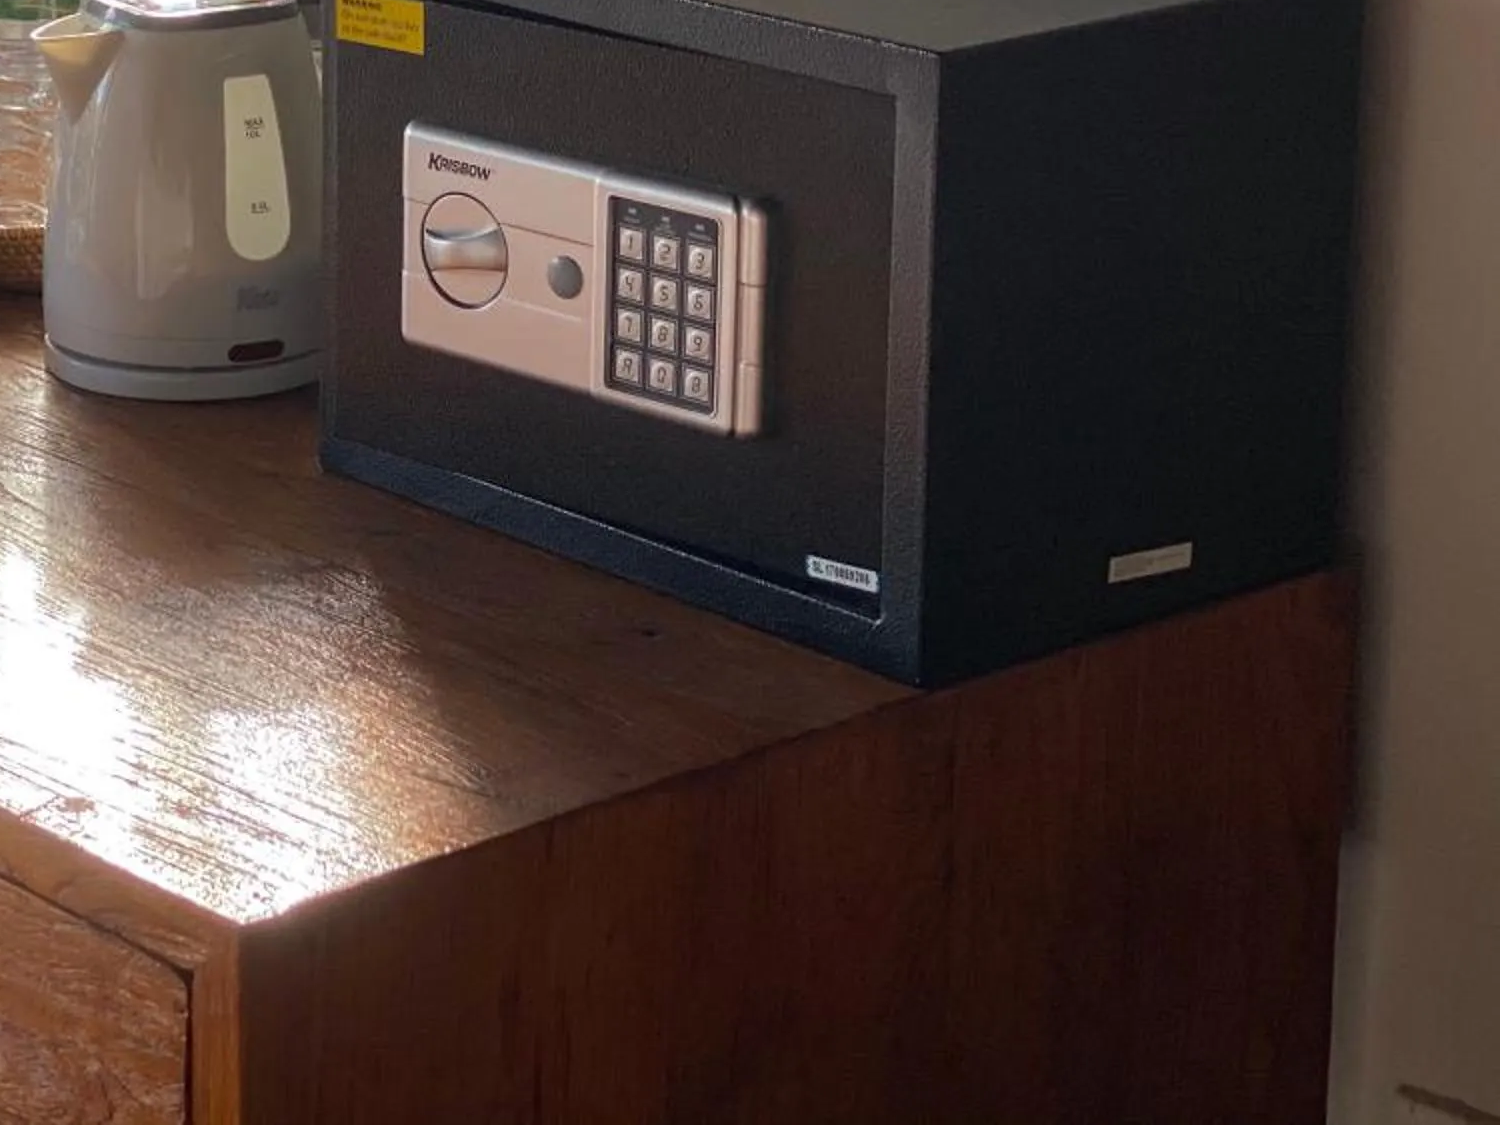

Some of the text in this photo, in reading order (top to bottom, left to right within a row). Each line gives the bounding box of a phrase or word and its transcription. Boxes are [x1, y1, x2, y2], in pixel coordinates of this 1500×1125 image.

[658, 243, 671, 262] 2
[695, 252, 705, 270] 3
[624, 274, 704, 311] 4 5 6
[624, 315, 703, 352] 7 8 9
[657, 366, 667, 384] 0
